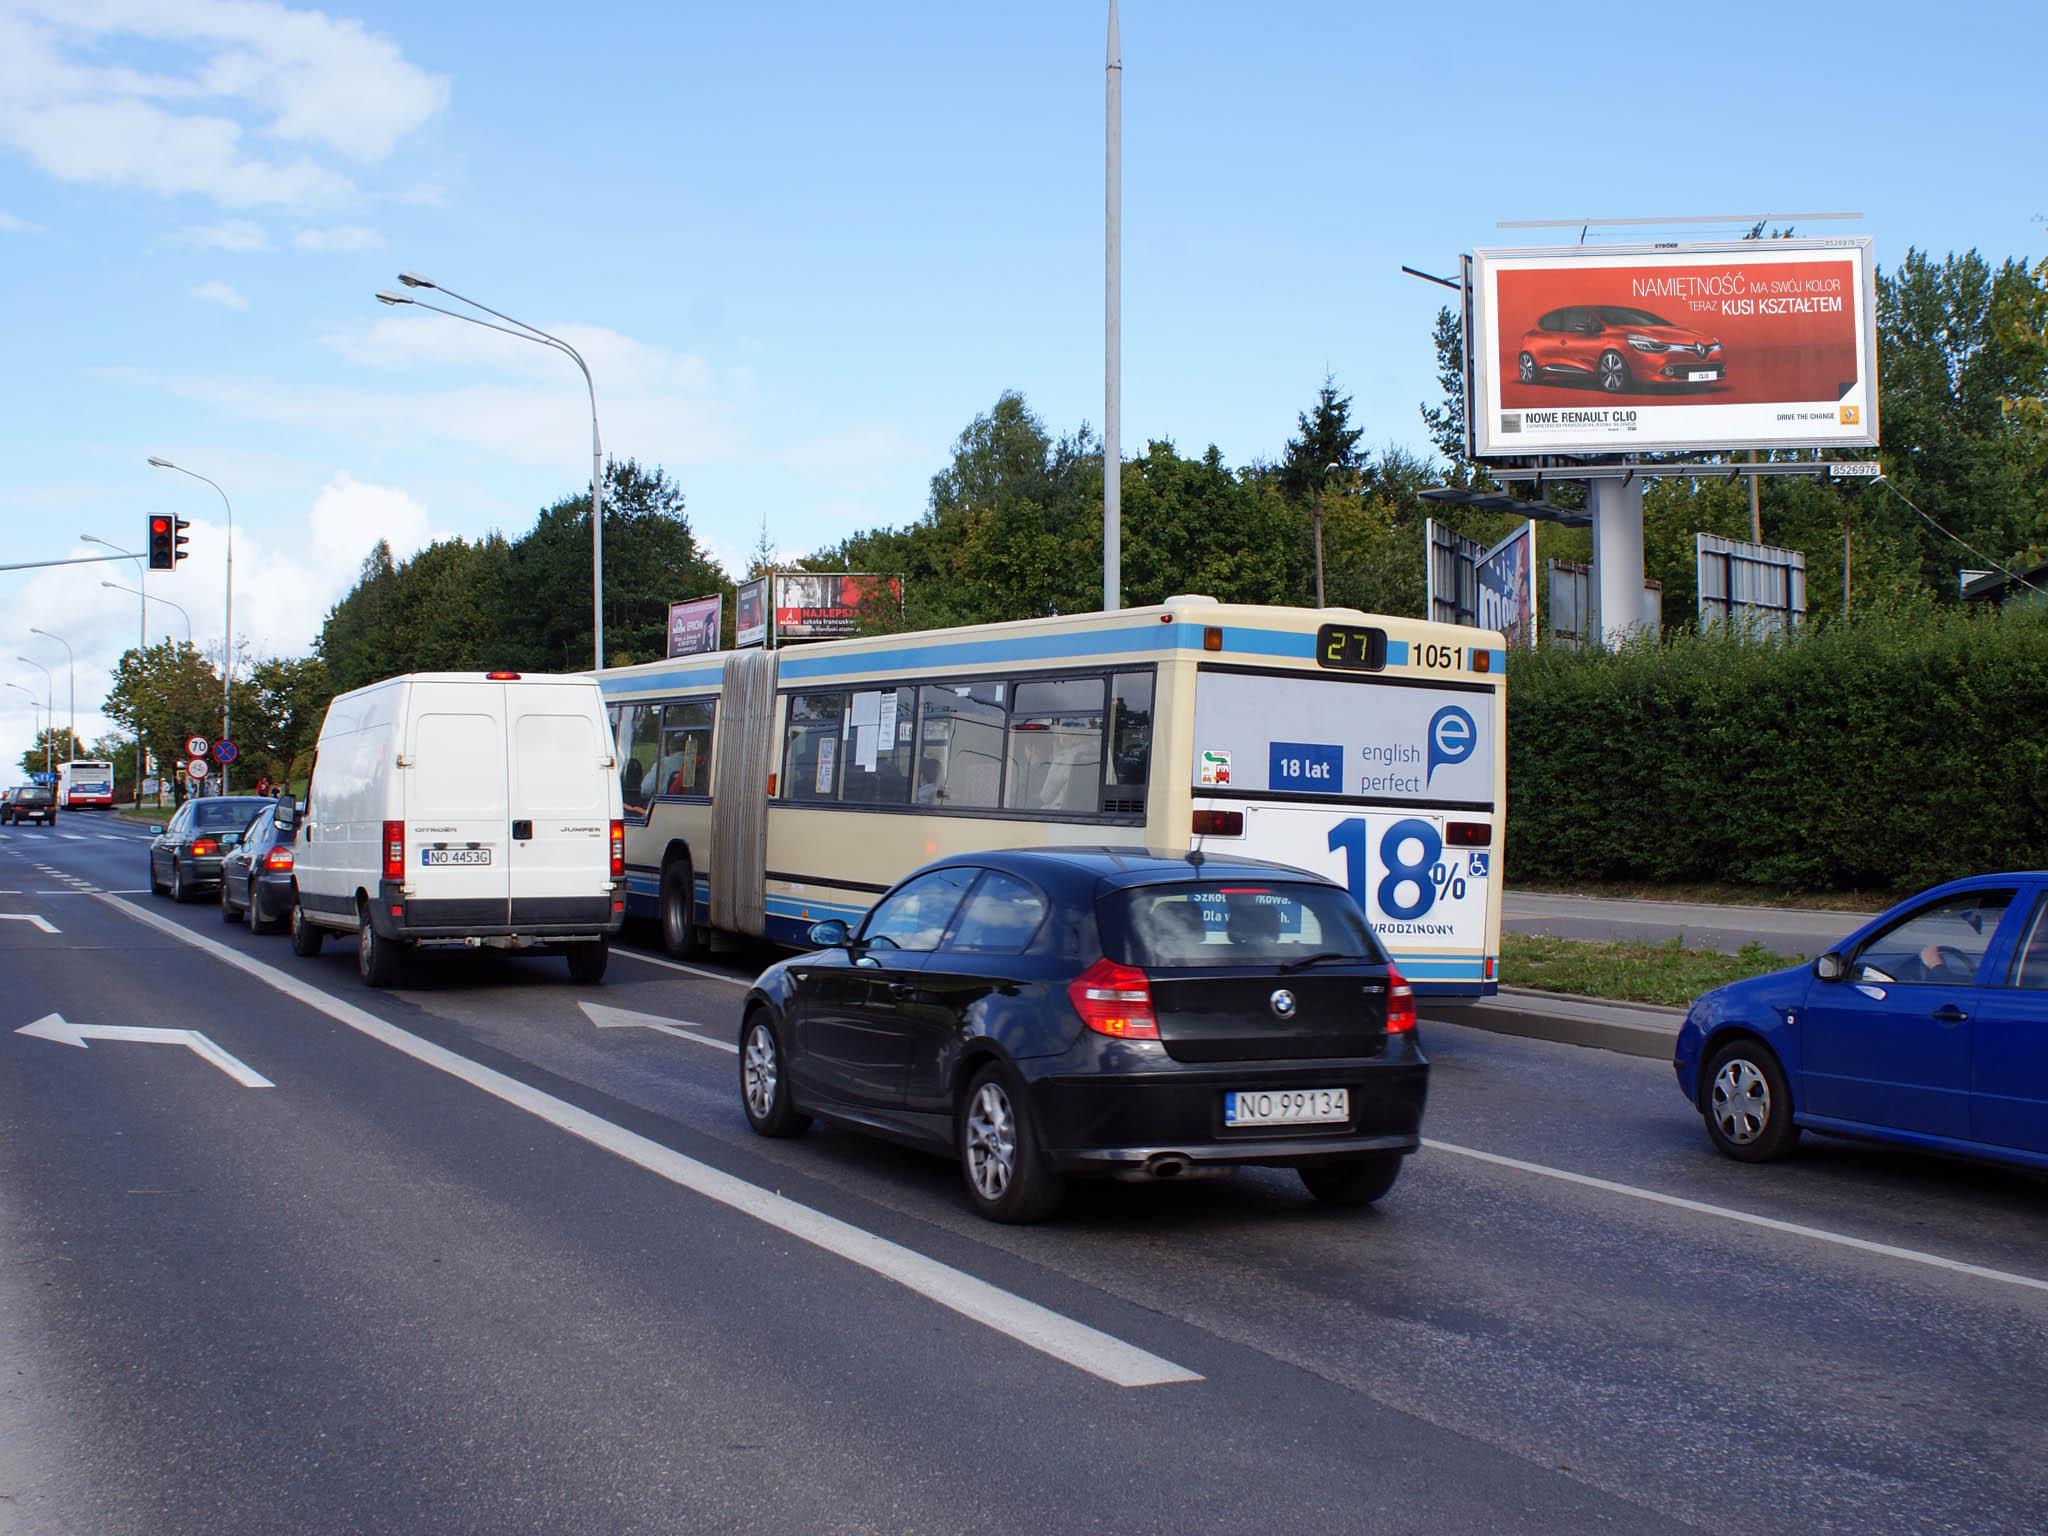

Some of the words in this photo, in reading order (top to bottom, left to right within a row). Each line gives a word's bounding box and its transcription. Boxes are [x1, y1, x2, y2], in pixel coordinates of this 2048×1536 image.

[1632, 271, 1746, 301] NAMIĘTNOŚĆ
[1750, 281, 1769, 294] MA
[1771, 277, 1802, 294] SWÓJ
[1805, 278, 1841, 292] KOLOR
[1688, 300, 1718, 312] TERAZ
[1721, 299, 1754, 316] KUSI
[1759, 296, 1842, 315] KSZTAŁTEM
[1525, 412, 1559, 424] NOWE
[1561, 411, 1610, 423] RENAULT
[1612, 410, 1637, 422] CLIO
[1776, 413, 1796, 421] DRIVE
[1797, 413, 1809, 421] THE
[1809, 412, 1835, 420] CHANGE
[1832, 465, 1877, 475] 8526976
[1327, 632, 1368, 661] 27
[1412, 643, 1462, 670] 1051
[191, 741, 207, 752] 70
[1362, 744, 1420, 766] english
[1280, 758, 1300, 777] 18
[1305, 760, 1330, 779] lat
[1361, 773, 1420, 794] perfect
[431, 852, 448, 864] NO
[452, 851, 488, 863] 4453G
[1202, 910, 1222, 922] Dla
[1241, 1094, 1272, 1118] NO
[1281, 1092, 1344, 1117] 99134
